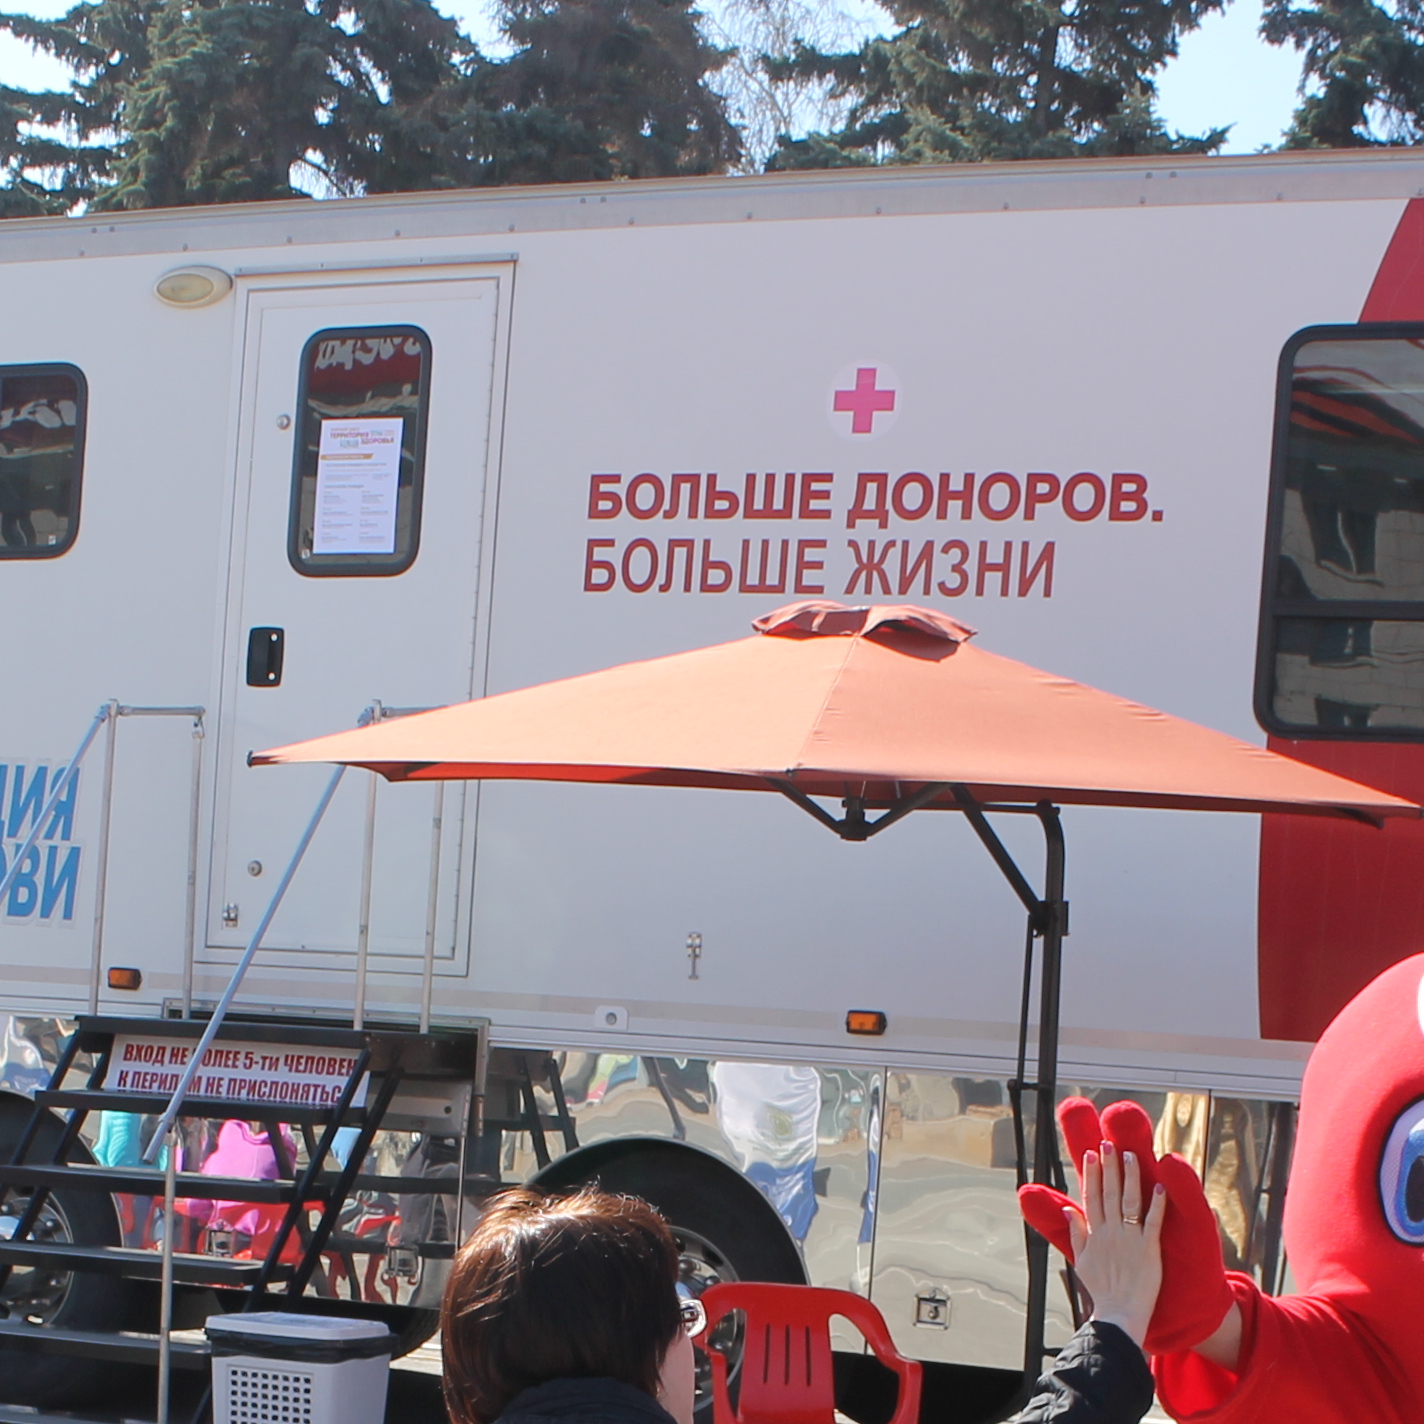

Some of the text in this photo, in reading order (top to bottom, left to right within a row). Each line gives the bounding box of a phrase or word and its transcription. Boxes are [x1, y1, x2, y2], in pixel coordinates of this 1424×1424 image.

[587, 472, 1164, 529] БОЛЬШЕ ДОНОРОВ.
[583, 538, 1056, 598] БОЛЬШЕ ЖИЗНИ
[123, 1043, 166, 1067] ВХОД
[169, 1047, 189, 1065] НЕ
[192, 1048, 241, 1069] ОЛЕЕ
[243, 1051, 280, 1071] 5-ти
[117, 1070, 342, 1104] К ПЕРИЛМ НЕ ПРИСЛОНЯТЬС
